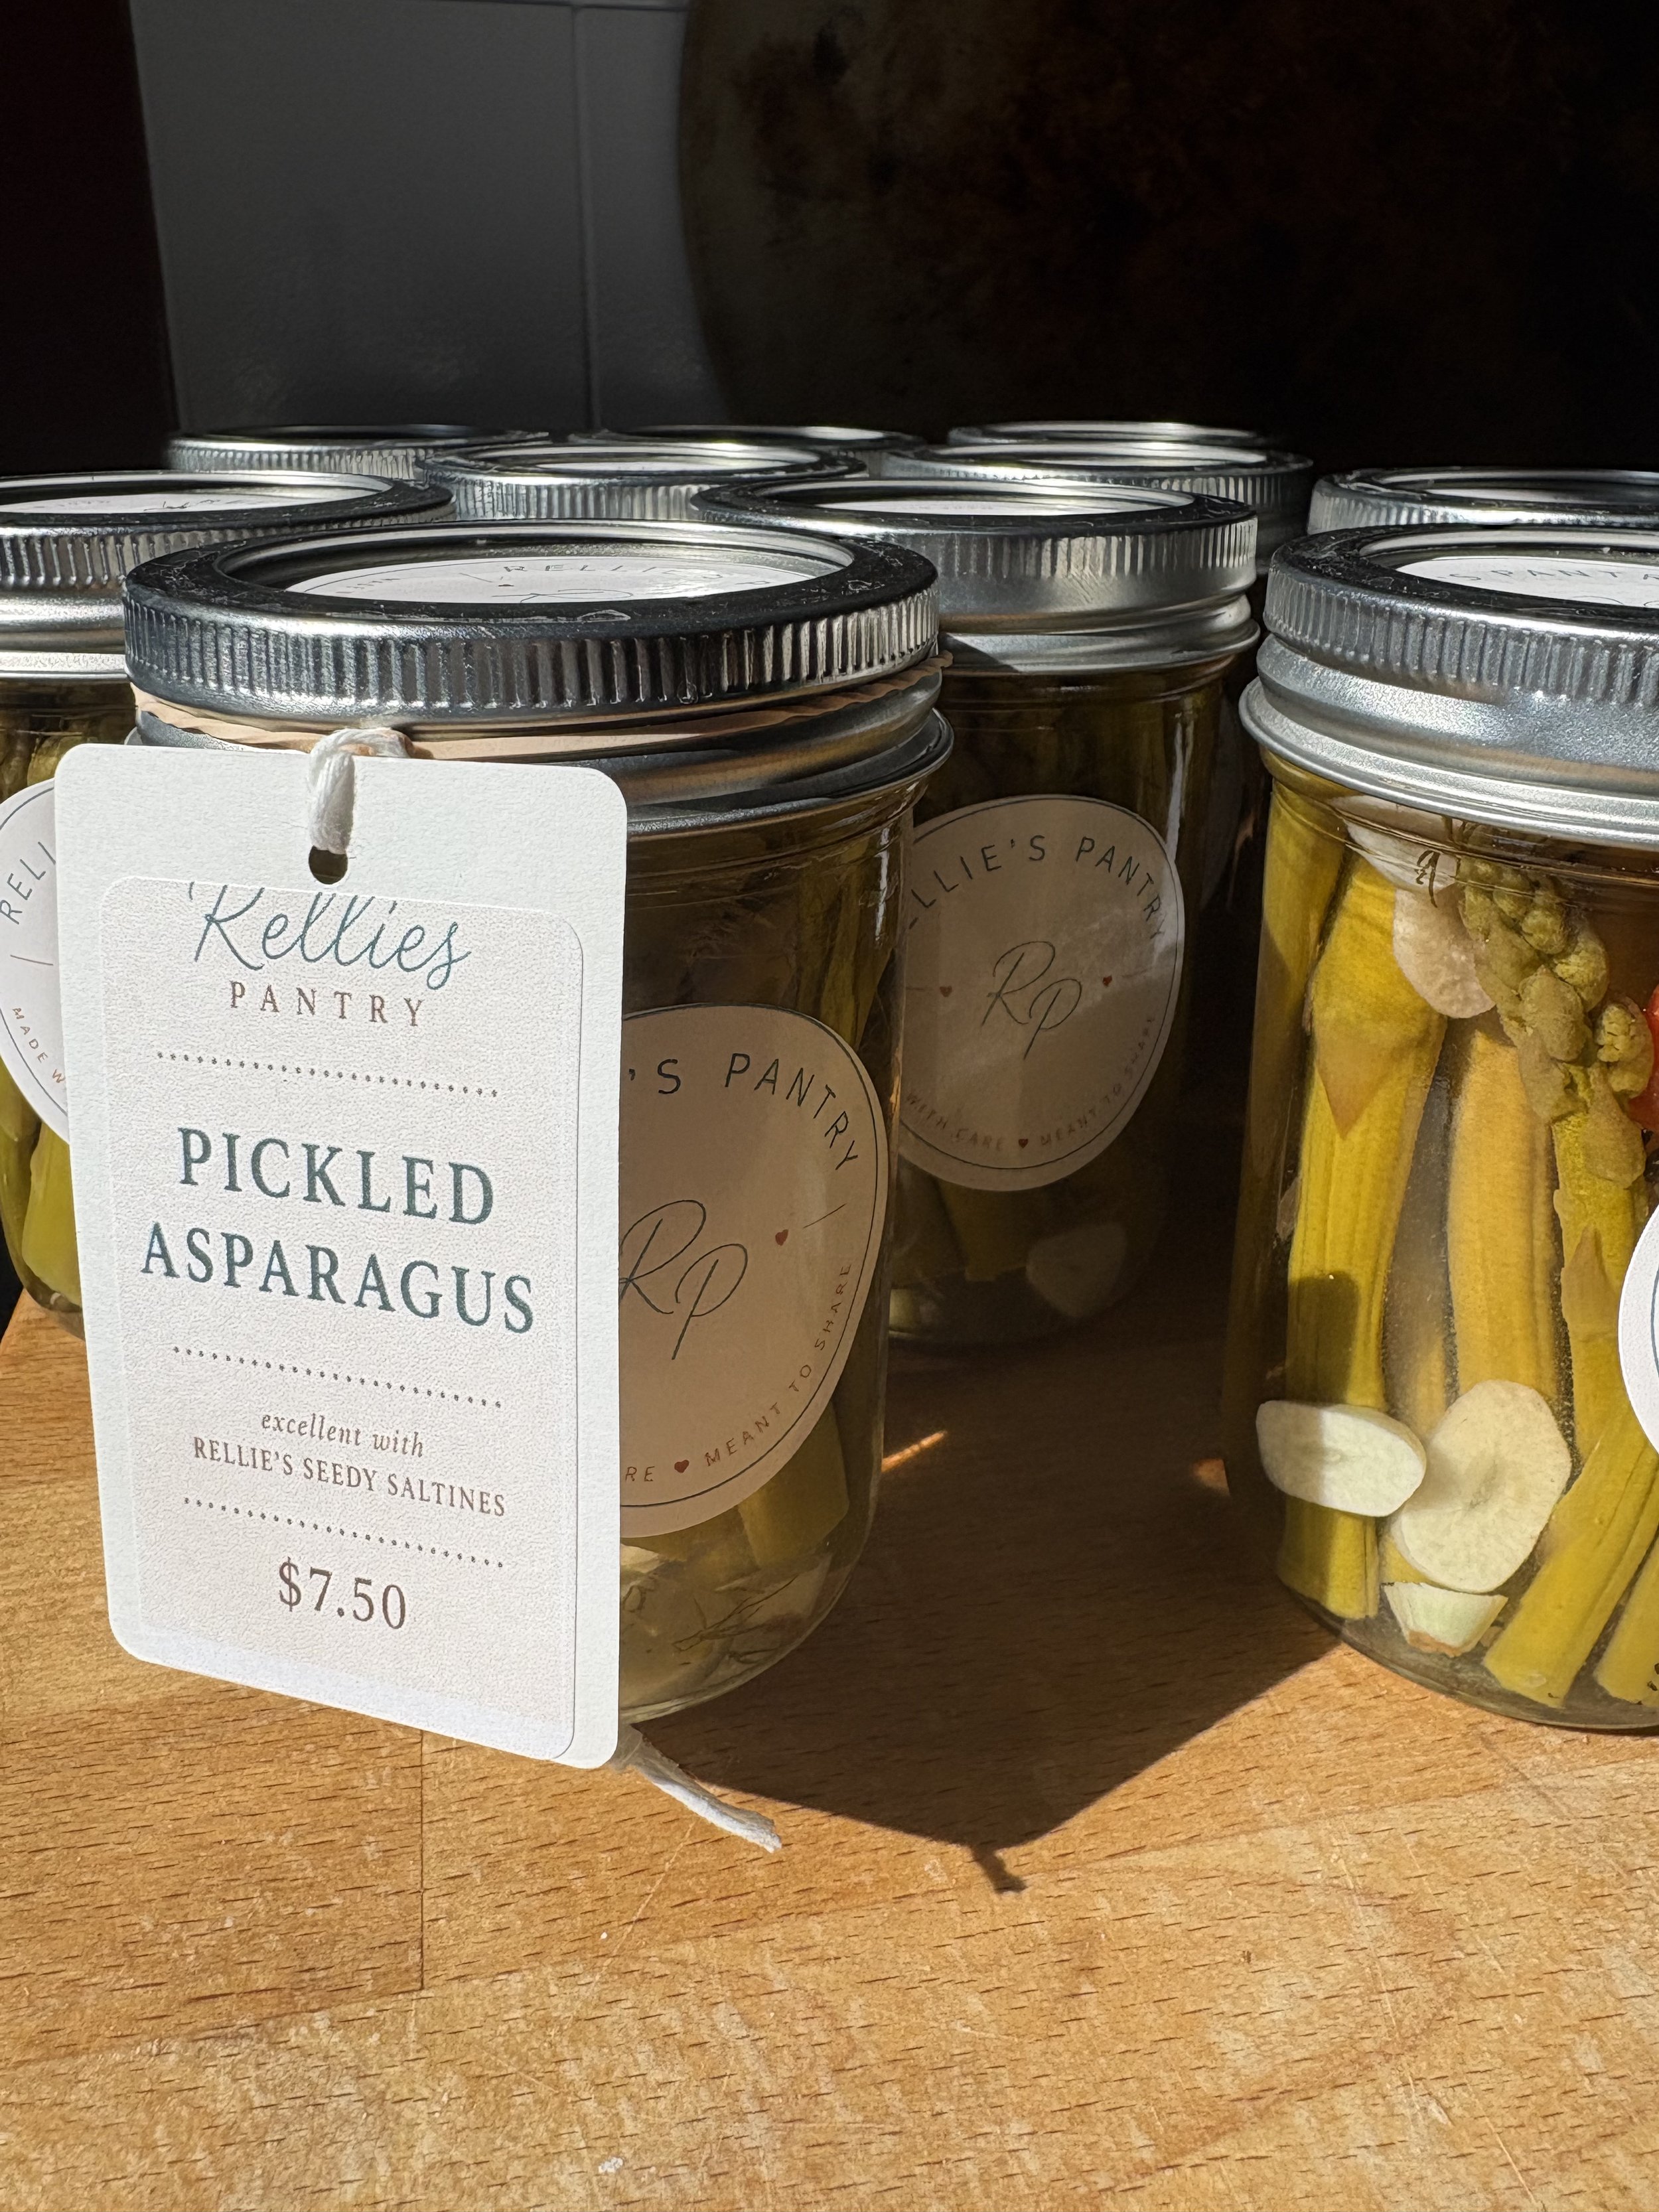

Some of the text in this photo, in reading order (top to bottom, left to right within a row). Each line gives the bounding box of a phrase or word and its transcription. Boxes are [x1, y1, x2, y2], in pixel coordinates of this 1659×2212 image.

[910, 835, 1168, 940] LLIE'S PANTRY
[12, 1007, 48, 1063] MADE
[230, 980, 425, 1027] PANTRY
[724, 1053, 859, 1171] PANTRY
[179, 1128, 494, 1225] PICKLED
[141, 1221, 533, 1334] ASPARAGUS
[625, 1264, 853, 1483] RE MEANT TO SHARE
[193, 1436, 507, 1518] RELLIE'S SEEDY SALTINES
[261, 1411, 425, 1459] excellent with
[278, 1556, 406, 1629] $7.50
